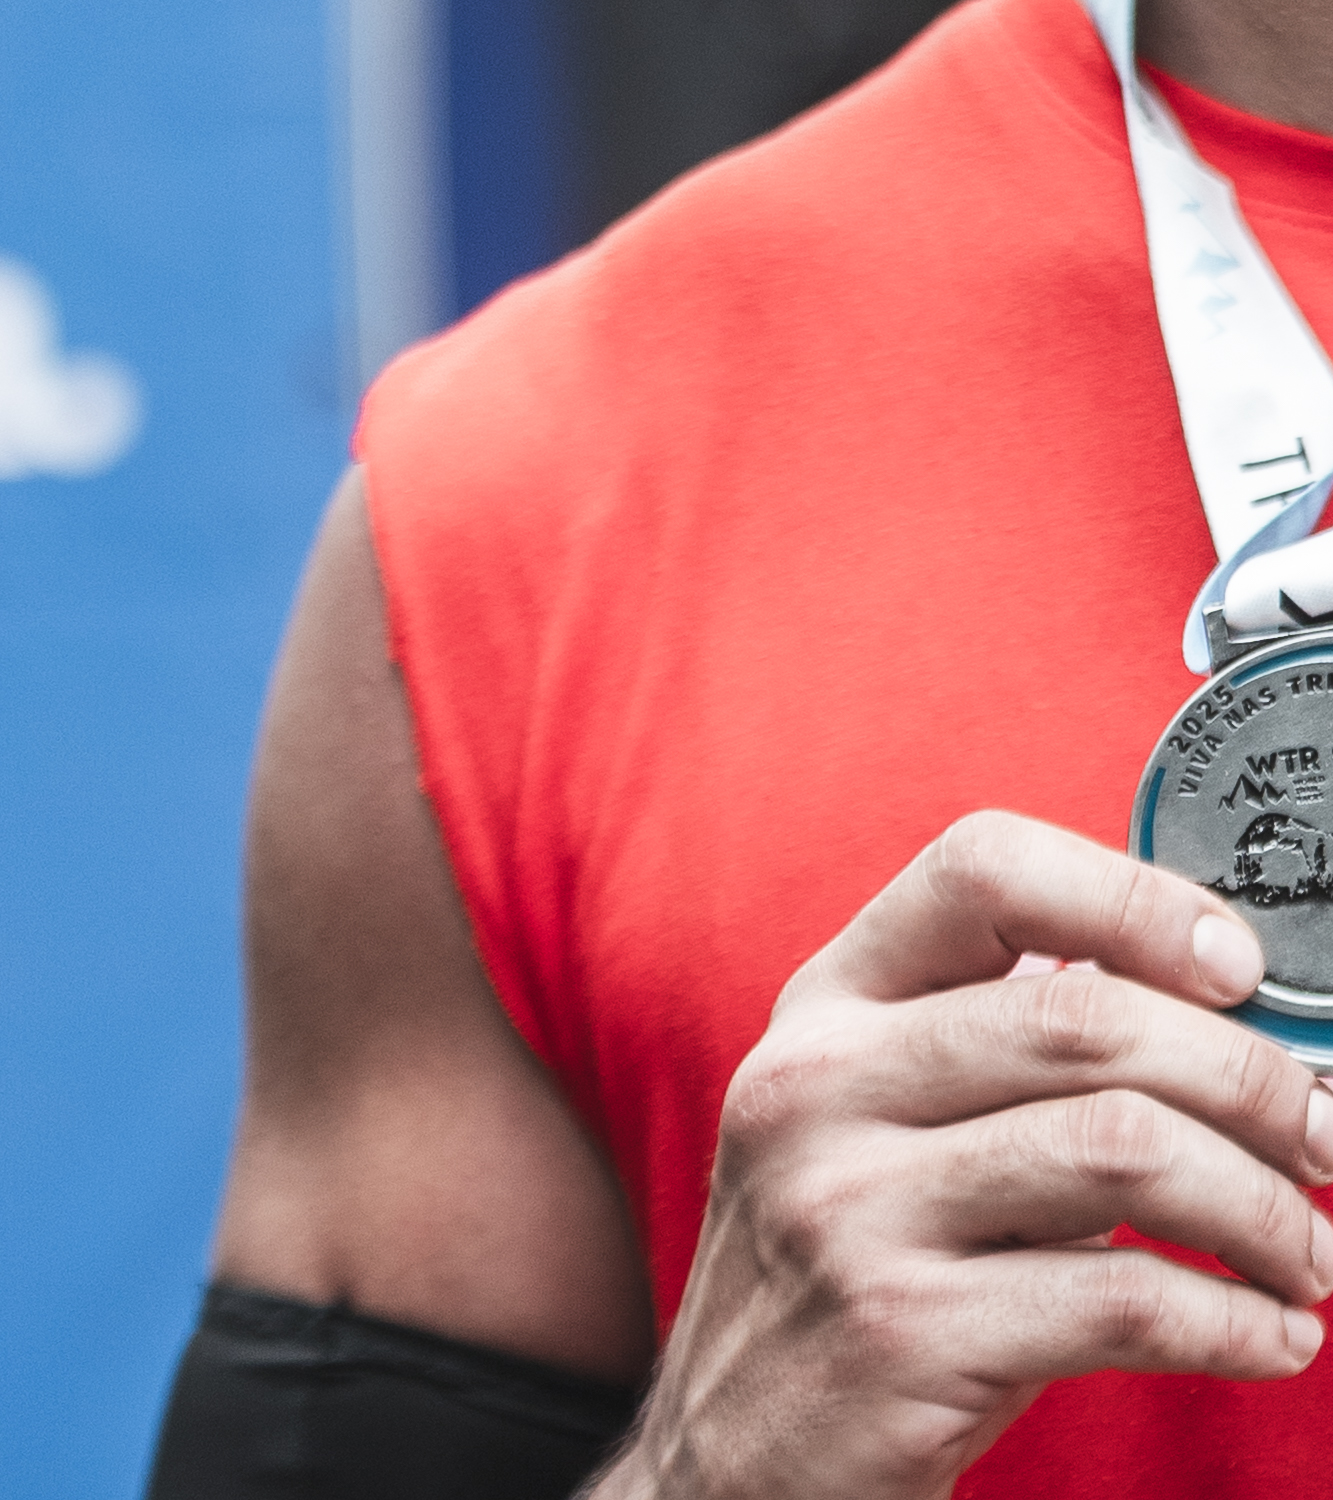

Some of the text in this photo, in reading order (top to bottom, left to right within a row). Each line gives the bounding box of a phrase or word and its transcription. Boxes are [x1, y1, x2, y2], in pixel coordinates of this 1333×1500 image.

[1168, 684, 1234, 758] 2025
[1178, 733, 1227, 797] VIVA
[1222, 687, 1277, 732] NAS
[1245, 746, 1322, 782] WTR
